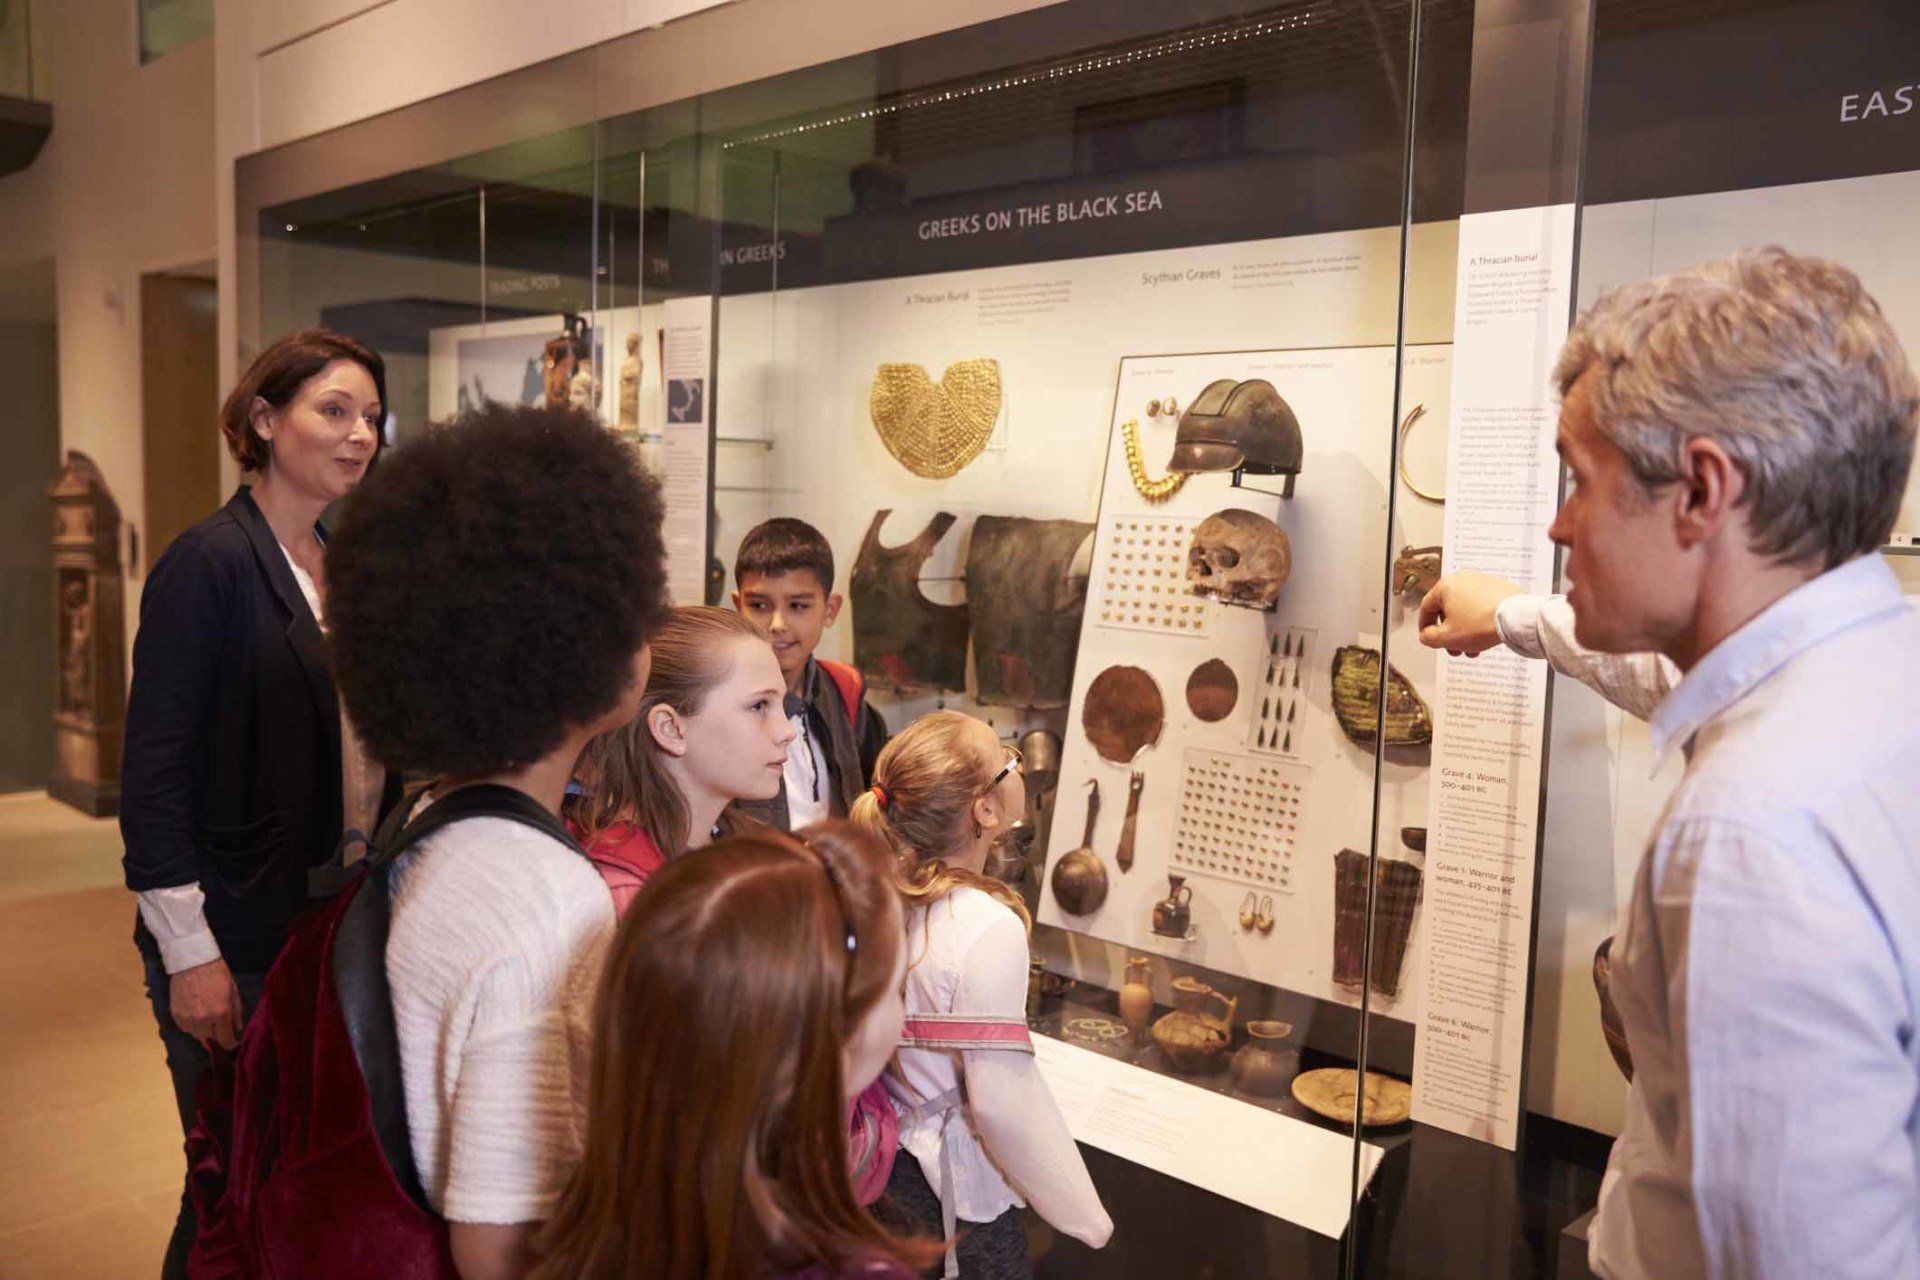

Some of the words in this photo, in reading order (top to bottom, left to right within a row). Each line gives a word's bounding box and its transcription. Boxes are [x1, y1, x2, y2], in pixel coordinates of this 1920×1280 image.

[1841, 84, 1920, 122] EAS
[918, 213, 980, 240] GREEKS
[985, 210, 1011, 231] ON
[1016, 205, 1051, 227] THE
[1057, 195, 1119, 222] BLACK
[1125, 190, 1163, 213] SEA
[1142, 268, 1184, 288] Scythian
[1186, 267, 1222, 281] Graves
[1441, 767, 1465, 779] Grave
[1436, 861, 1459, 873] Grave
[1500, 874, 1516, 884] and
[1427, 1011, 1450, 1023] Grave
